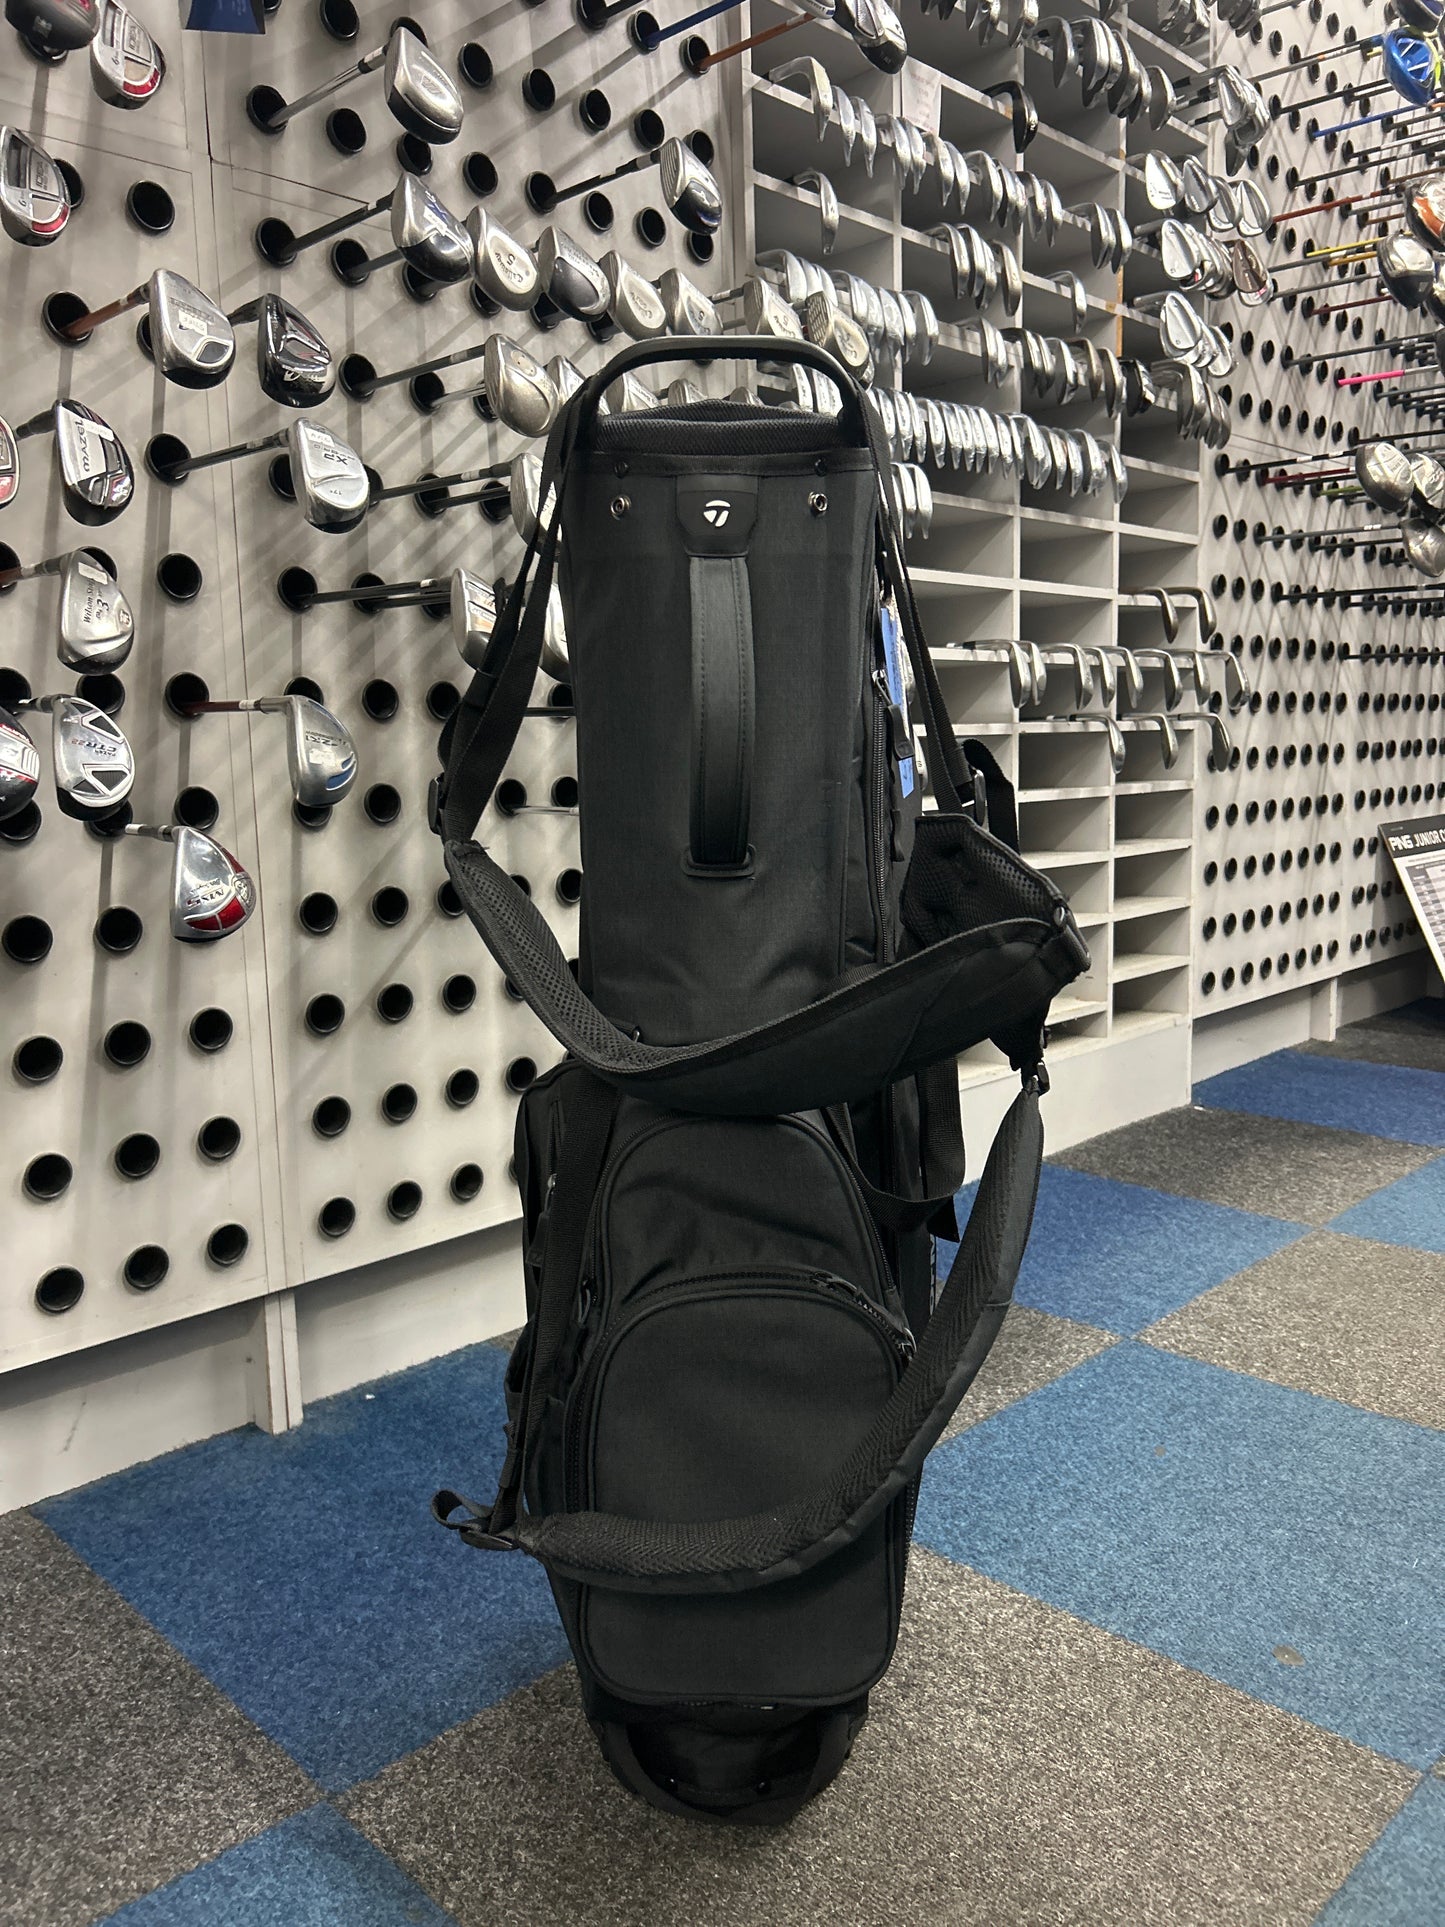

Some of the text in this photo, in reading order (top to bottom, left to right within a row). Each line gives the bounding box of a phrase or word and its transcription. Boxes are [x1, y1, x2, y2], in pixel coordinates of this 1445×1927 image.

[506, 253, 516, 266] 5
[83, 597, 94, 624] Wilson
[1414, 830, 1441, 847] JUNIOR
